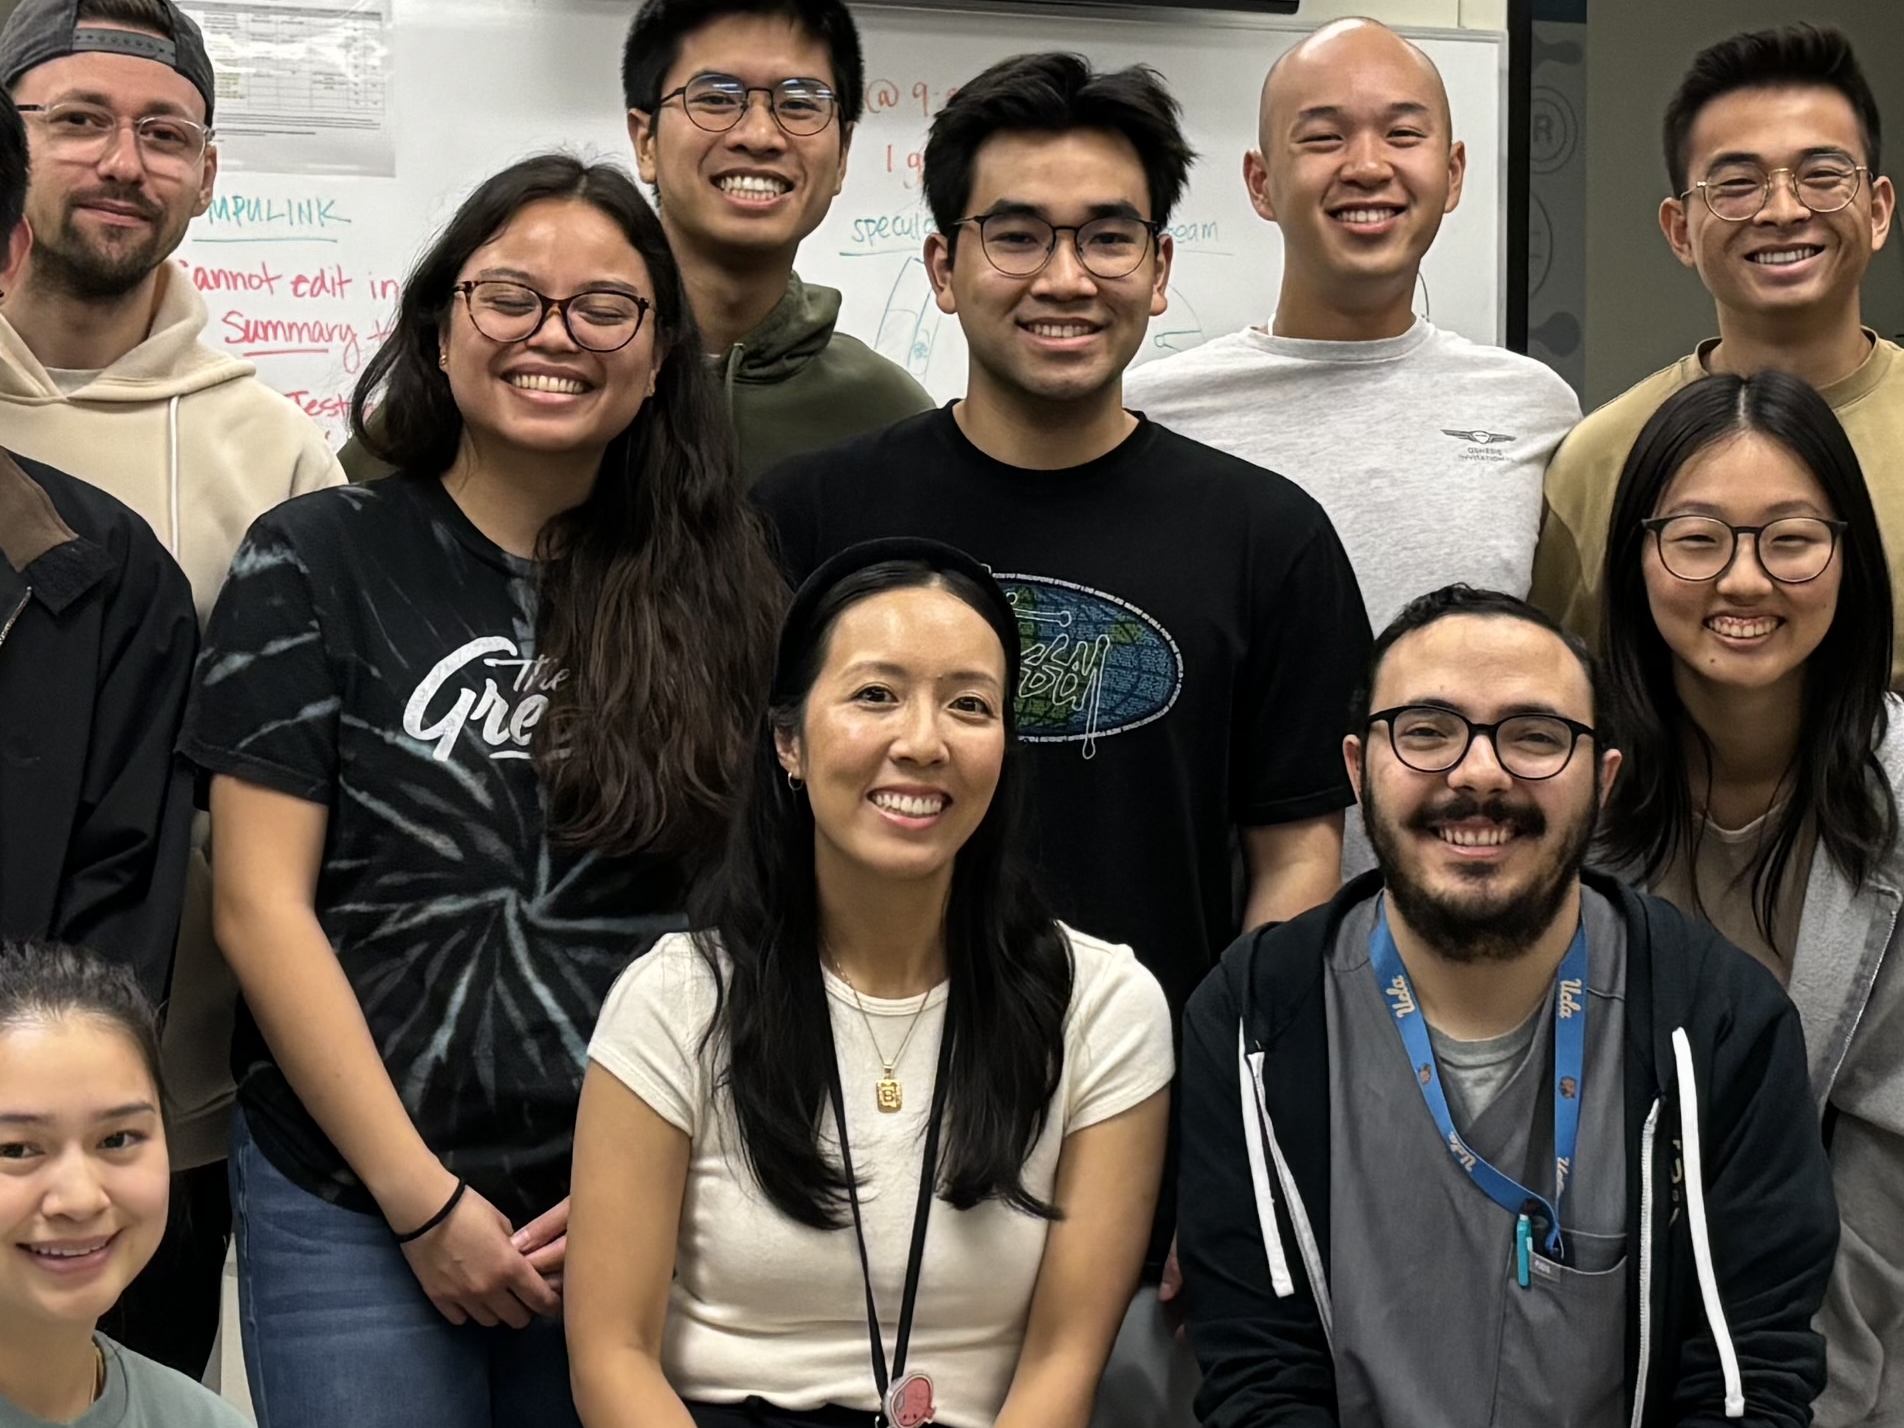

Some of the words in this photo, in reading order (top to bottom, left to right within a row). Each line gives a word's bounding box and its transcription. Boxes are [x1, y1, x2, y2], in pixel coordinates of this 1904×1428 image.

[207, 194, 352, 228] MPULINK
[851, 213, 940, 247] specula
[179, 259, 283, 295] annot
[289, 264, 353, 299] edit
[221, 310, 361, 374] Summary
[402, 635, 550, 762] Gre
